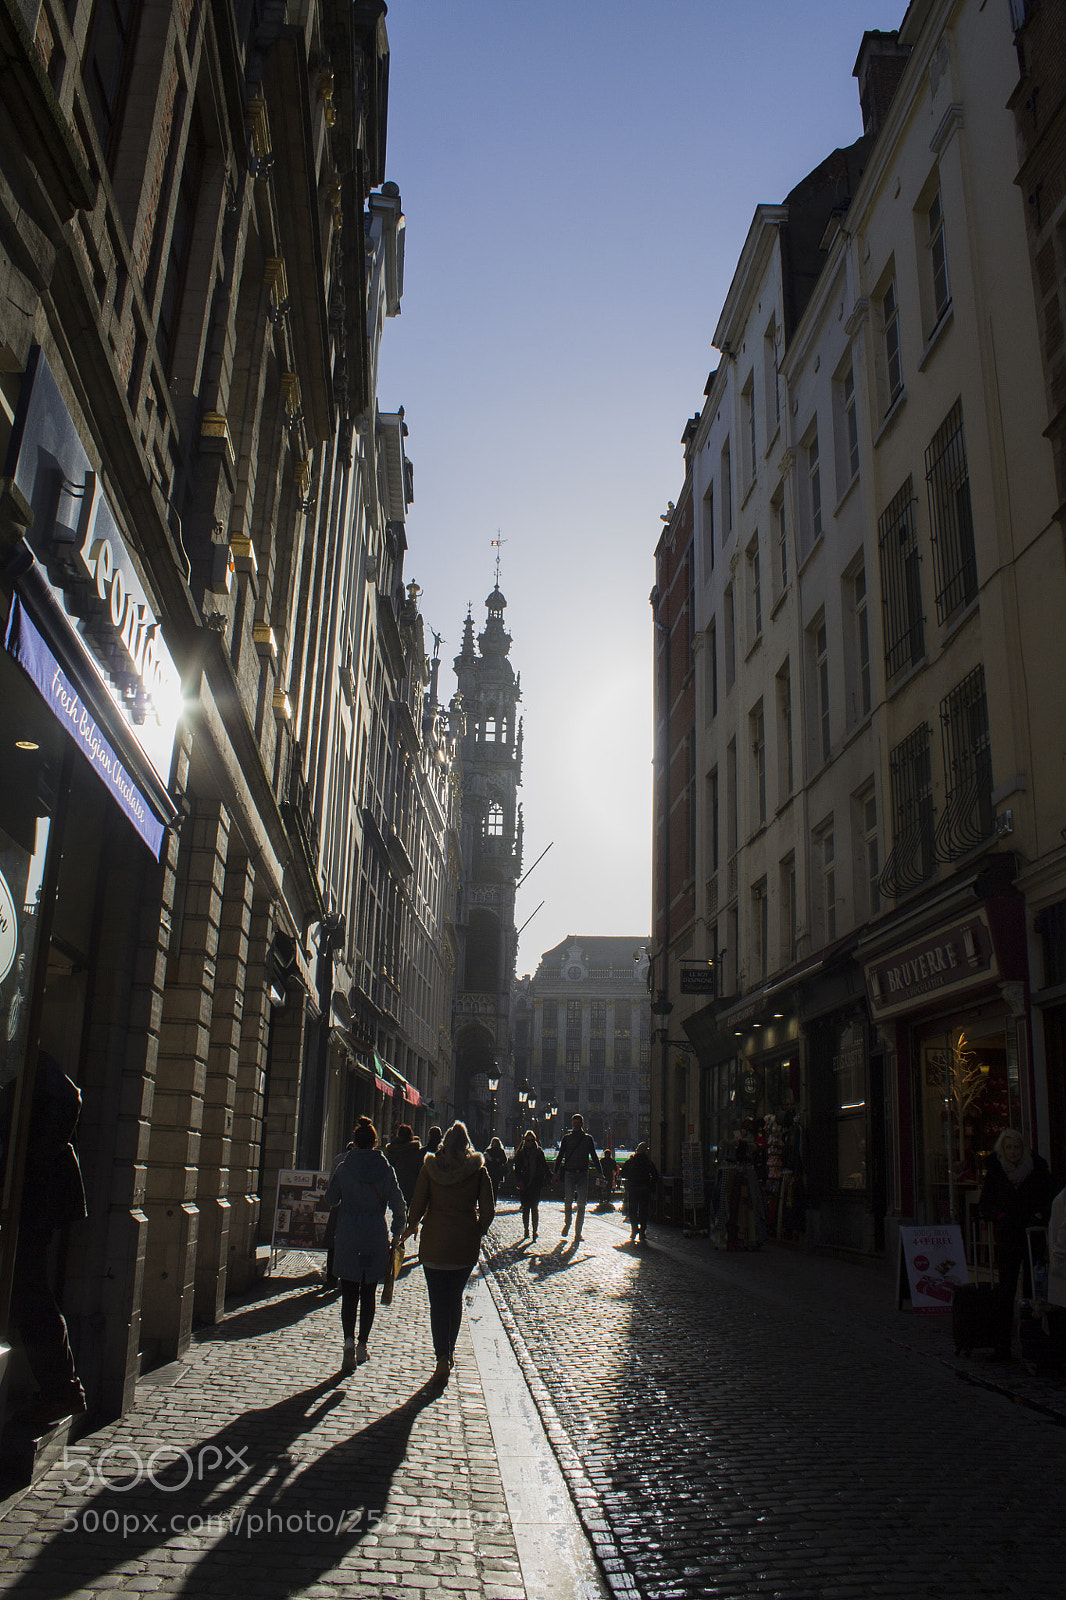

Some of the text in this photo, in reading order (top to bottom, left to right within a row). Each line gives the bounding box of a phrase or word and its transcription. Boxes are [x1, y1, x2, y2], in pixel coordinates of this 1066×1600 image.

[79, 470, 172, 724] Leonida
[51, 663, 145, 823] Fresh Belgian Chocolates
[886, 942, 958, 993] BRUYERRE
